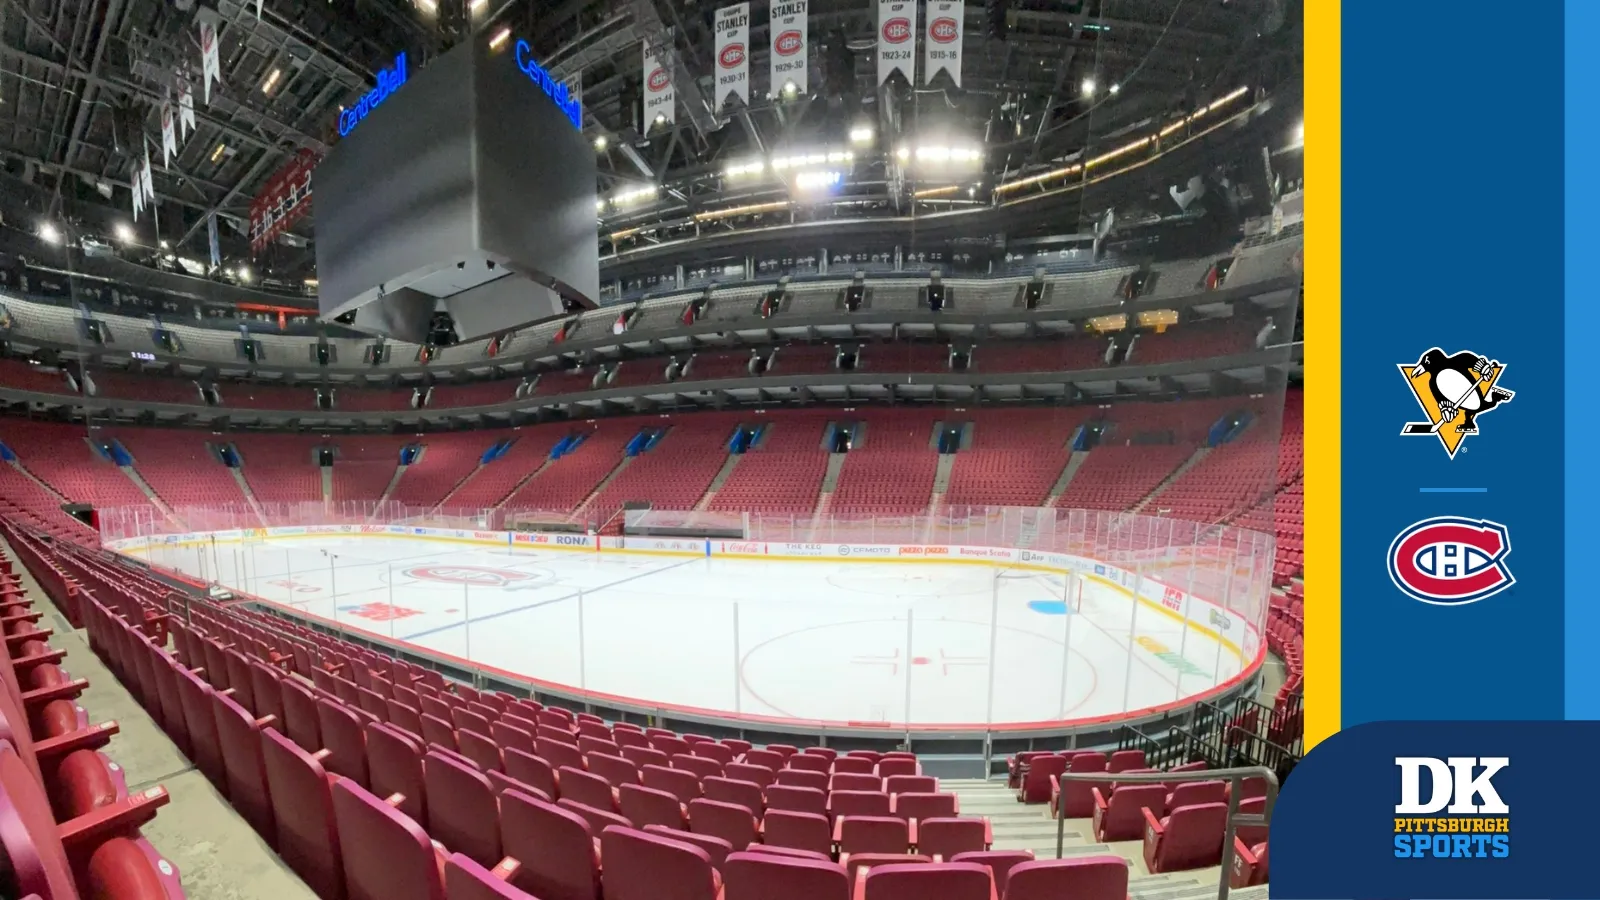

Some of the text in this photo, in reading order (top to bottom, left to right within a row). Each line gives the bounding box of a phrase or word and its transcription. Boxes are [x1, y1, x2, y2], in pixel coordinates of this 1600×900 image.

[772, 1, 806, 19] STANLEY
[717, 15, 748, 33] STANLEY
[882, 51, 911, 60] 1923-24
[556, 536, 589, 545] RONA
[960, 547, 987, 556] Banque
